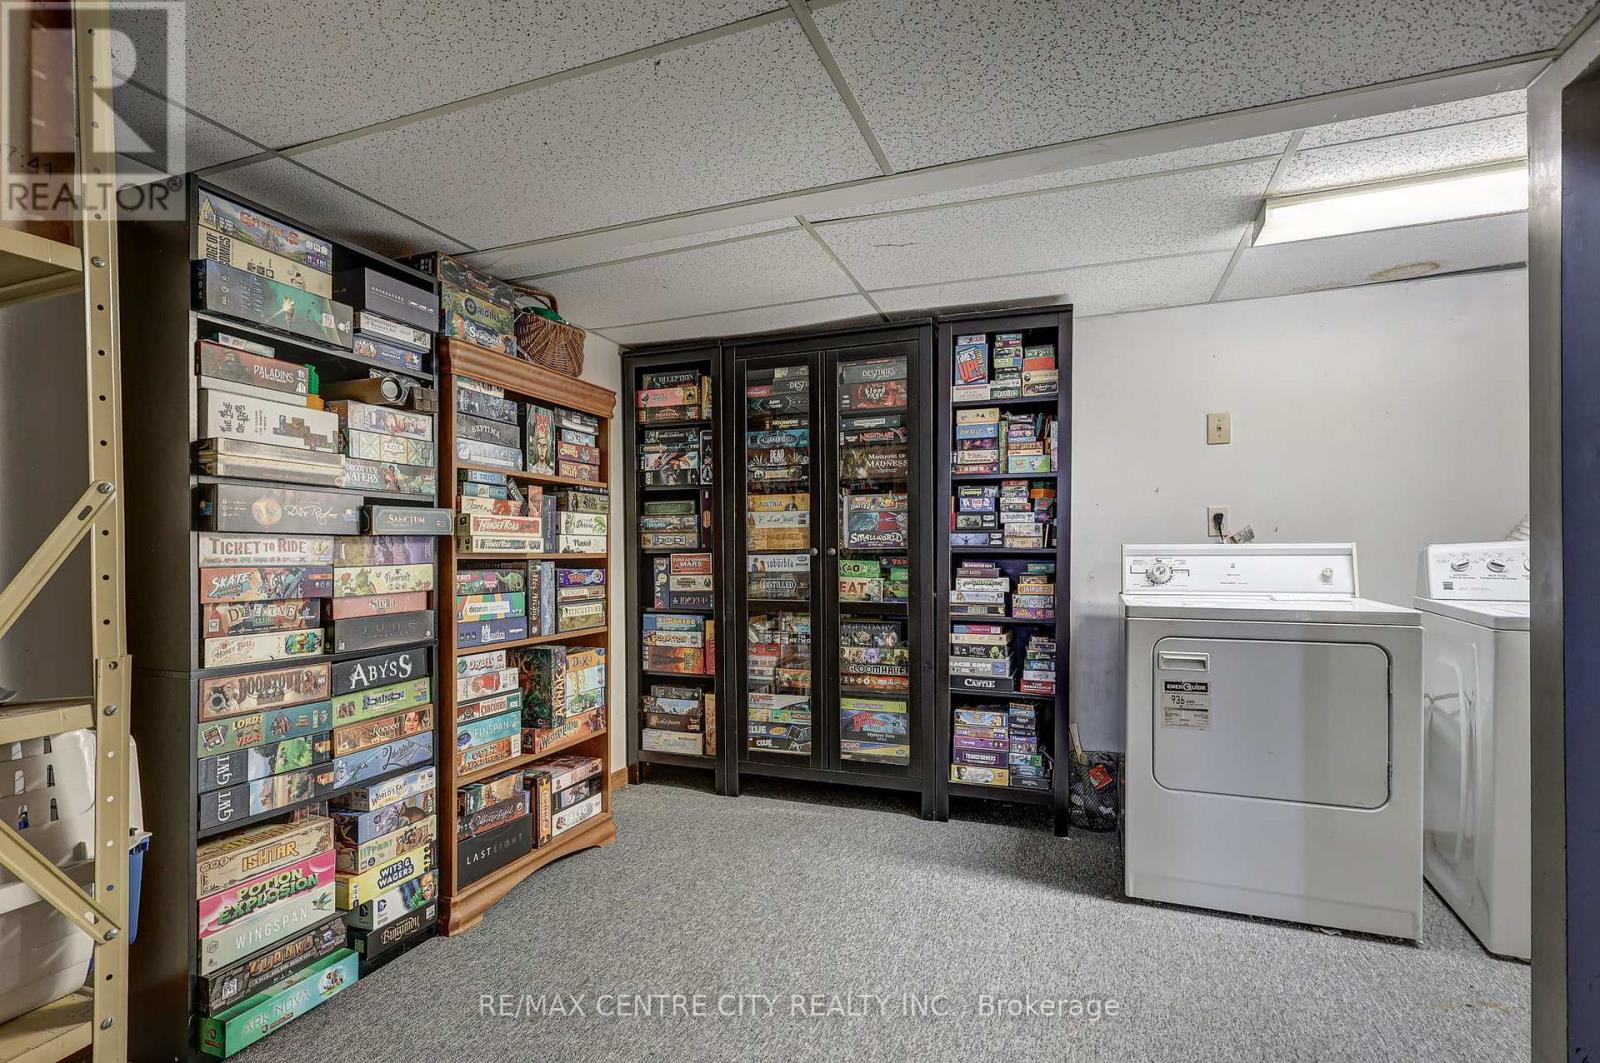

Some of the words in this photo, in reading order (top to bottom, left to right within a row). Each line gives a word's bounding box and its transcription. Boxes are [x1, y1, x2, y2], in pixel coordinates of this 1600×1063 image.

[253, 364, 294, 384] PALADINS
[788, 381, 809, 392] DESTI
[866, 459, 908, 469] MADNESS
[209, 537, 261, 555] TICKET
[277, 537, 306, 554] RIDE
[349, 654, 413, 689] ABYSS
[1171, 695, 1185, 705] 936
[231, 714, 264, 731] LORDS
[217, 755, 233, 786] GWT
[217, 790, 233, 822] GWT
[242, 841, 300, 873] ISHTAR
[466, 847, 492, 866] LAST
[236, 867, 304, 901] POTION
[377, 866, 415, 889] WAGERS
[217, 873, 320, 926] EXPLOSION
[235, 906, 309, 950] WINGSPAN
[244, 1013, 269, 1033] ARK
[271, 988, 310, 1017] NOVA
